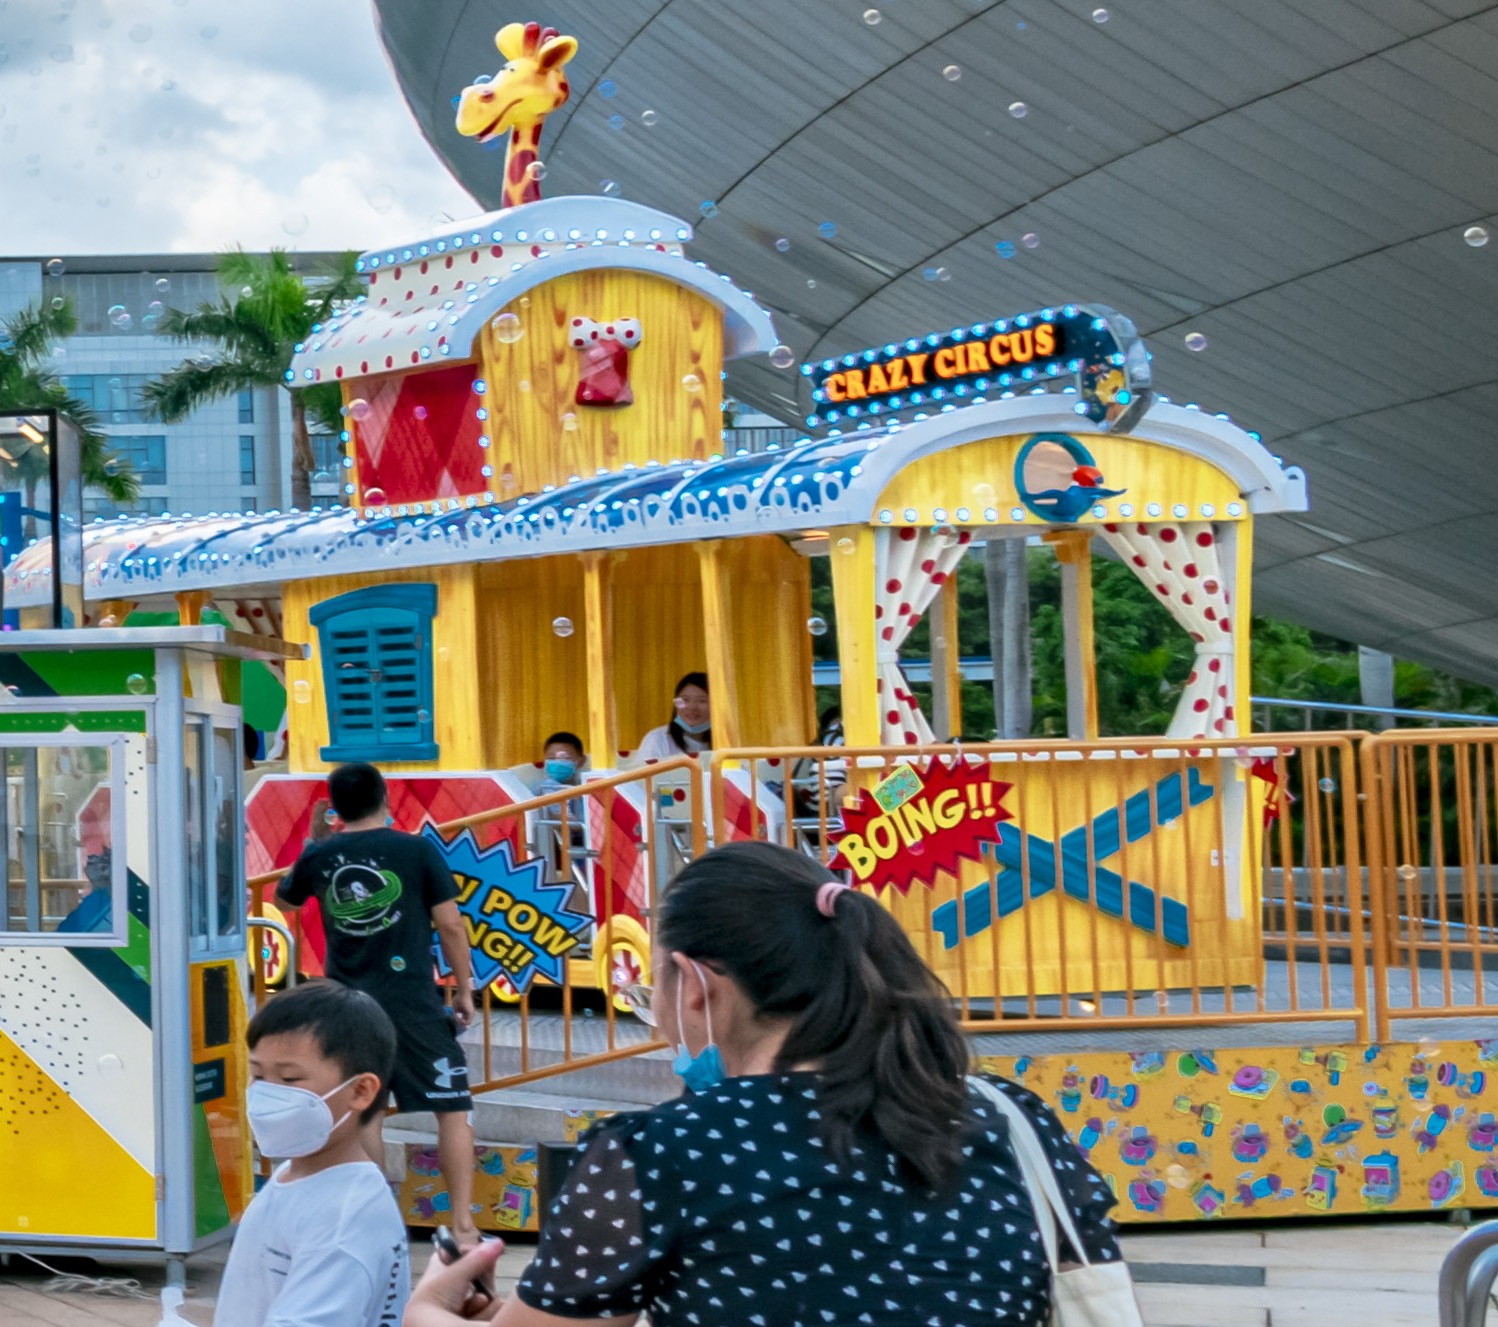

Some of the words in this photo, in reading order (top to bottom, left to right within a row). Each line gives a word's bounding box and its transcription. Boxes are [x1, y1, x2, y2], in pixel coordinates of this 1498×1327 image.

[825, 353, 929, 402] CRAZY
[933, 323, 1057, 379] CIRCUS
[838, 781, 997, 881] BOING!!
[482, 887, 580, 956] POW
